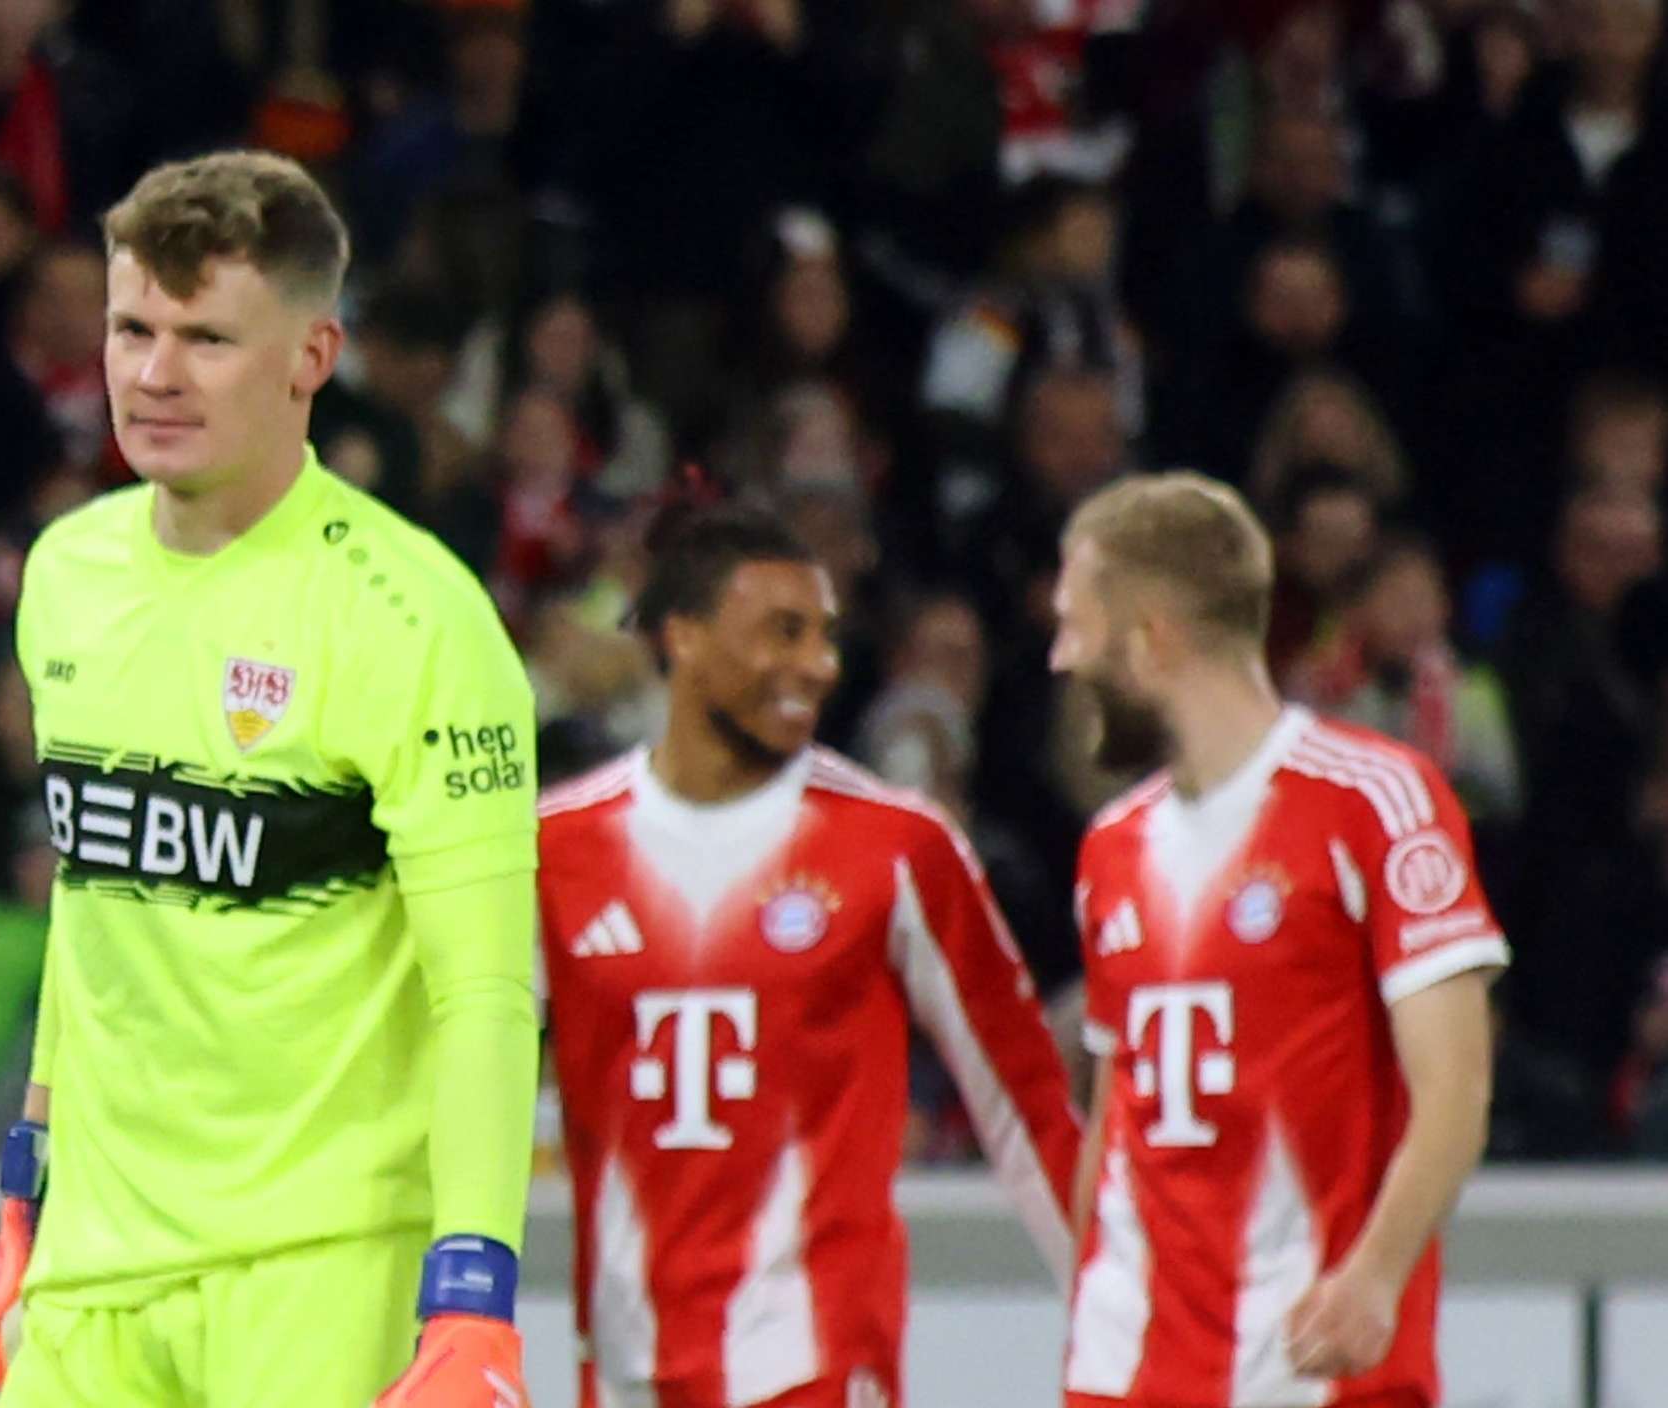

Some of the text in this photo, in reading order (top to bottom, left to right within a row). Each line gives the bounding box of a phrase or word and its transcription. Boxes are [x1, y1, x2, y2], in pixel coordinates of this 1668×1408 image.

[447, 722, 516, 762] hep
[630, 984, 758, 1150] T
[1125, 981, 1235, 1148] T
